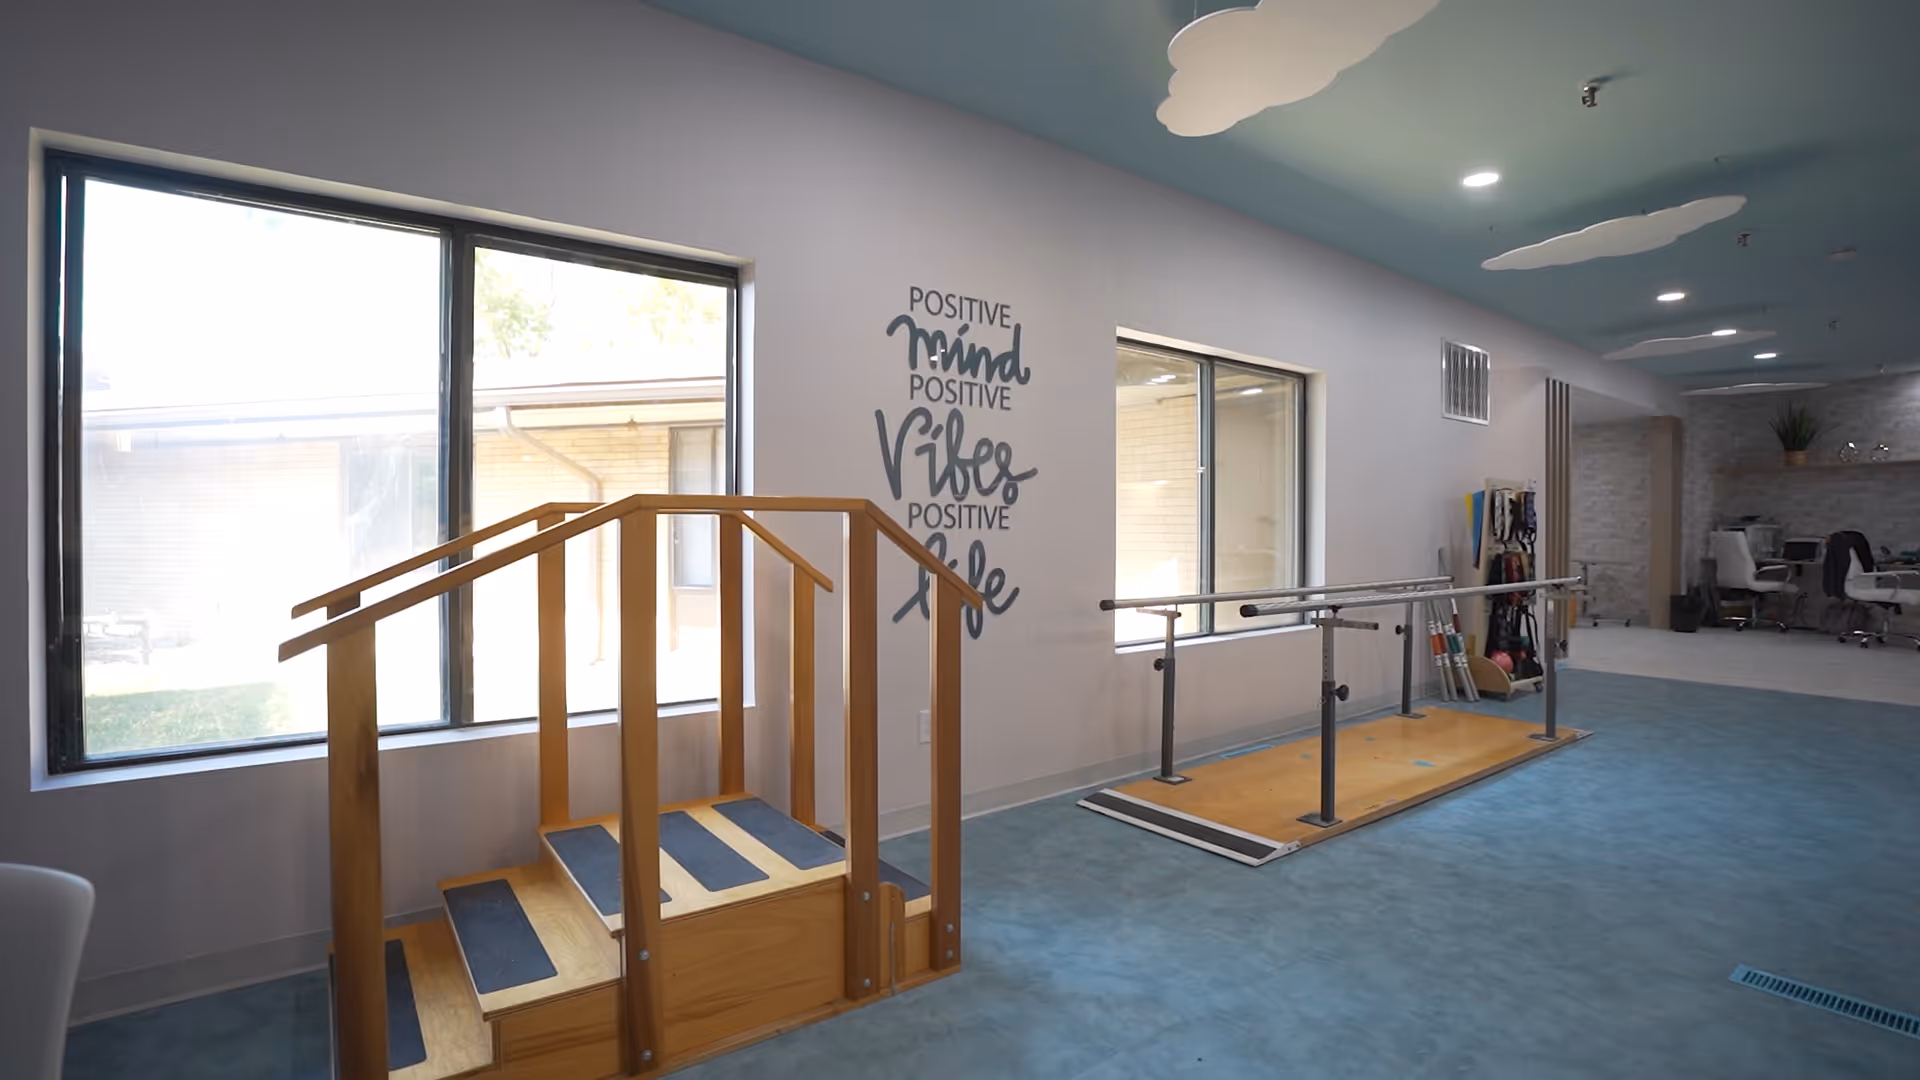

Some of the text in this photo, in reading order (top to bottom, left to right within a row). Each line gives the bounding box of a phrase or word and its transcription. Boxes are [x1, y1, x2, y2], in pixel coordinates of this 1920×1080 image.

[909, 286, 1011, 329] POSITIVE
[886, 314, 1031, 385] mind
[909, 374, 1011, 411] POSITIVE
[908, 502, 1010, 530] POSITIVE
[892, 531, 1020, 640] lfe
